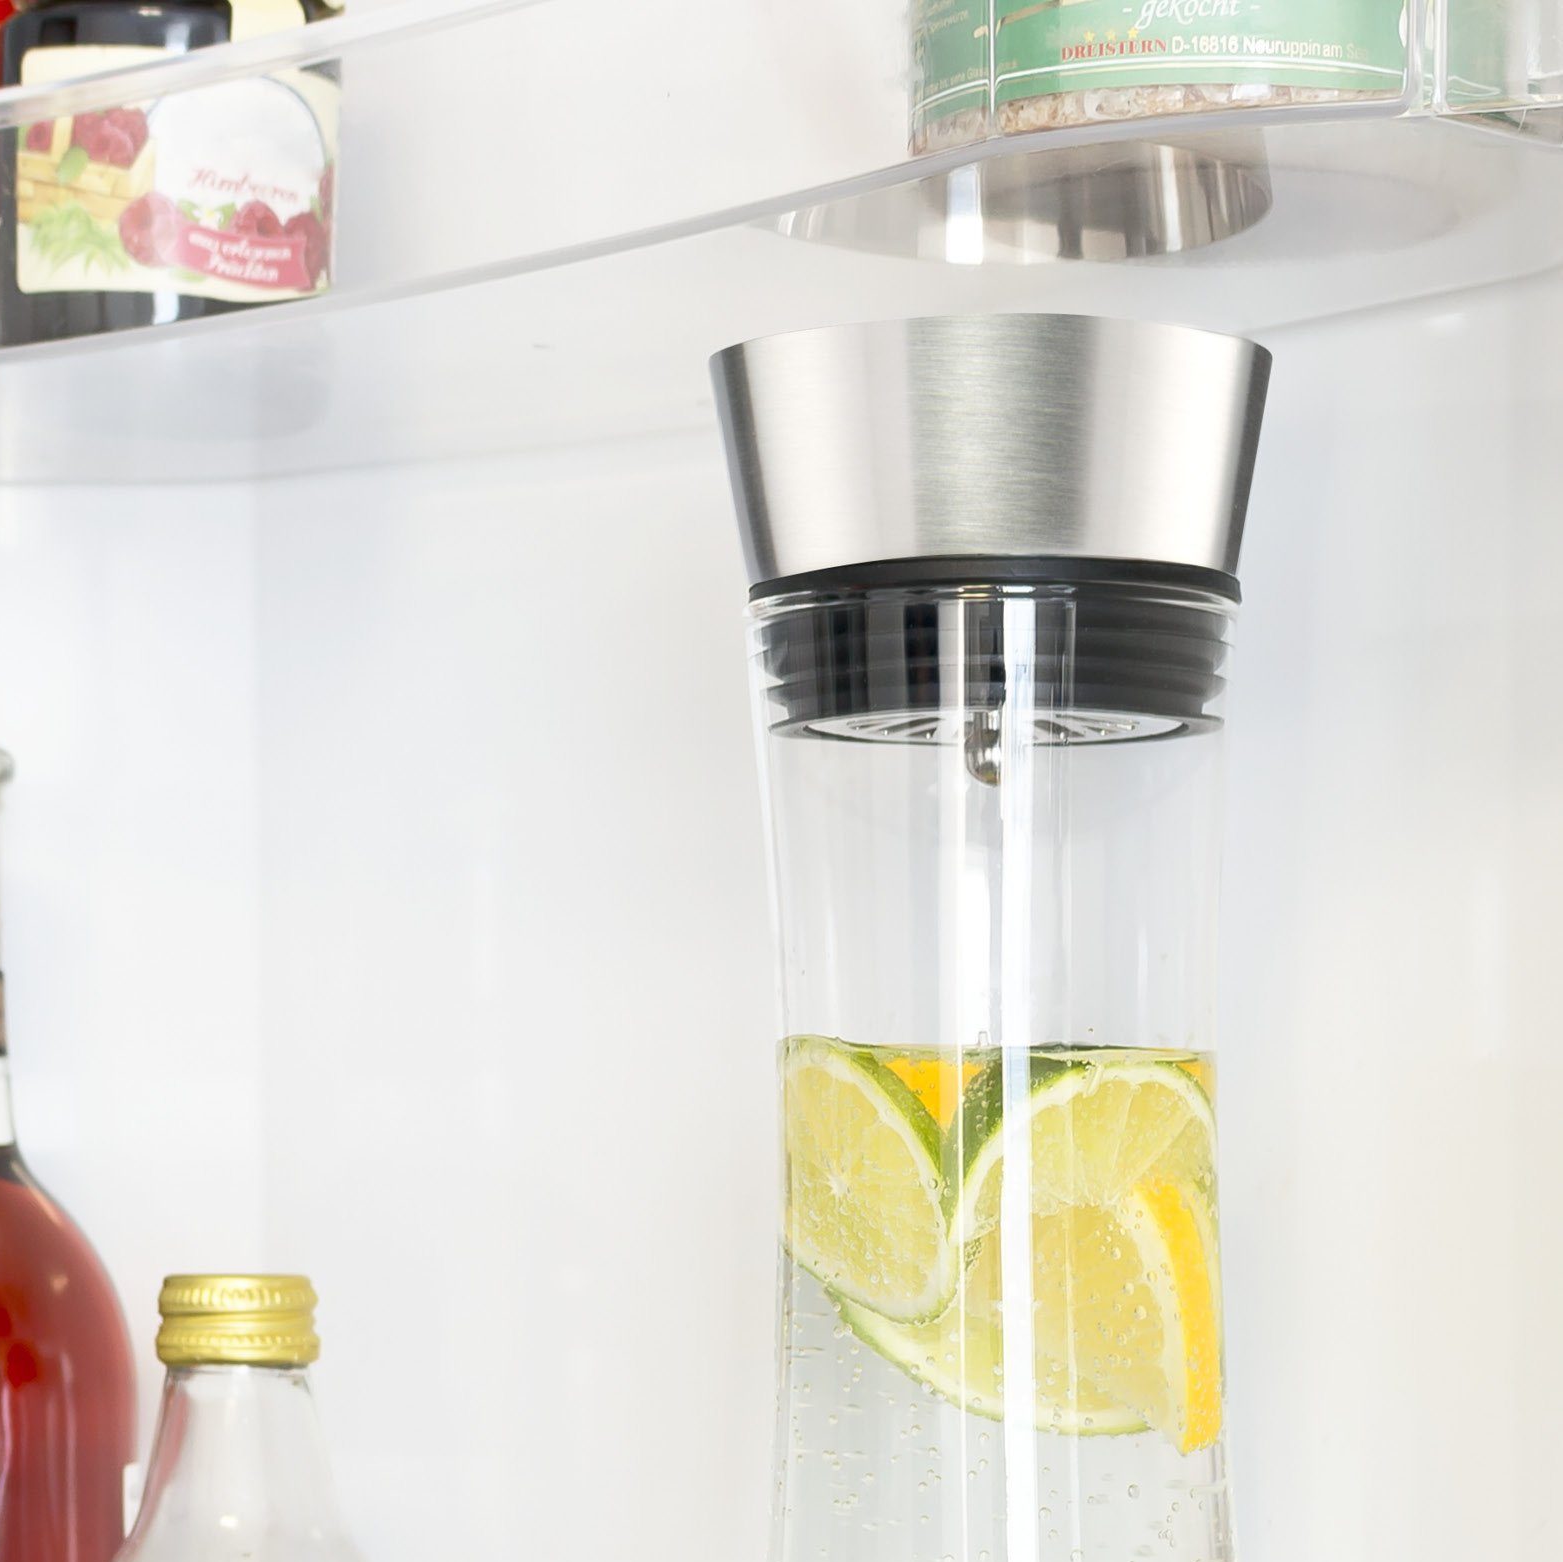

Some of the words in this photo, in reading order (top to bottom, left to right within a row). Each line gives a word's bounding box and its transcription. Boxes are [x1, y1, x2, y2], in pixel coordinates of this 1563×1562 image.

[1061, 38, 1167, 61] DREISTERN
[1171, 35, 1239, 55] D-16816
[1242, 36, 1321, 58] Neuruppin
[1322, 44, 1343, 59] am
